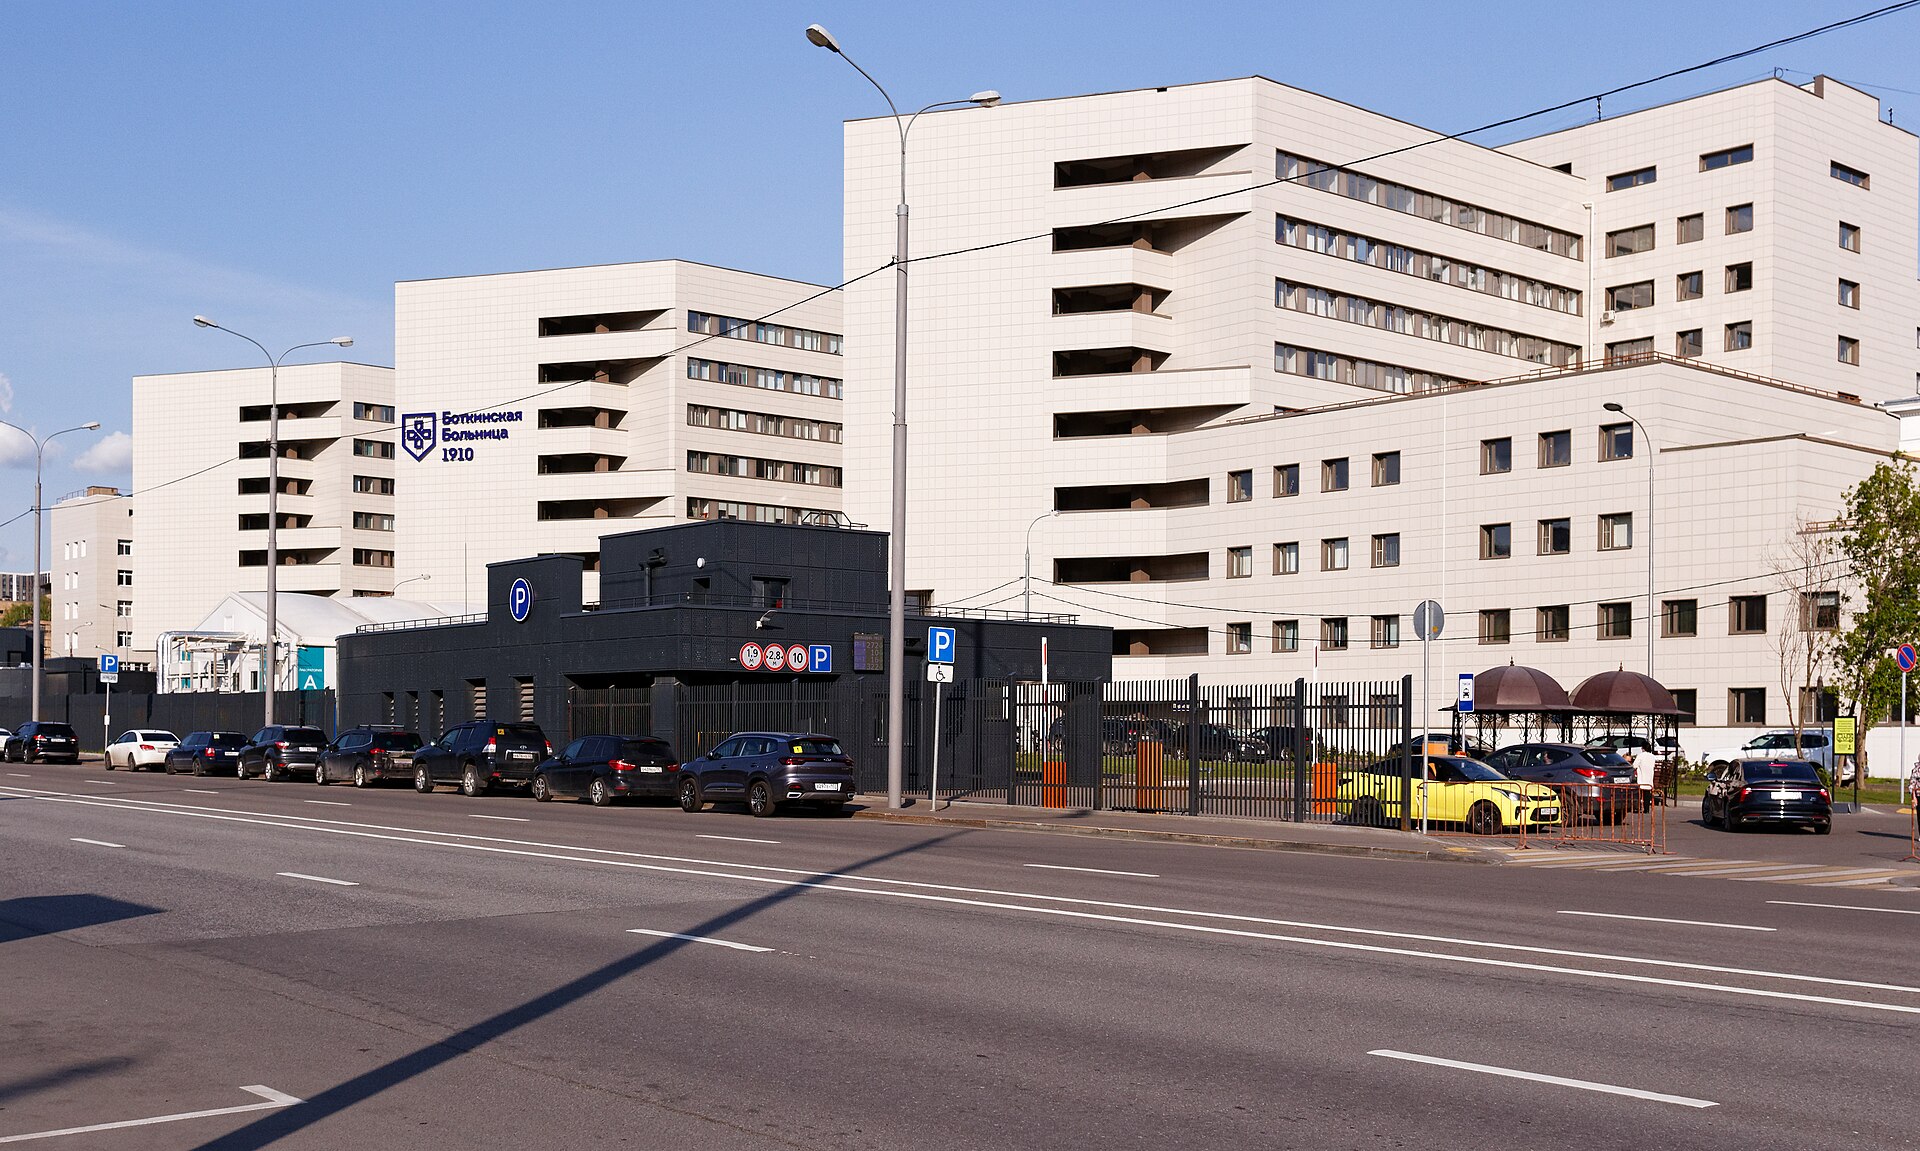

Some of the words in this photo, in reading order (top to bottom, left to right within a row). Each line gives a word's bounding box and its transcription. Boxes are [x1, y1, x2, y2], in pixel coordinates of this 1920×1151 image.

[442, 411, 523, 426] Боткинская
[442, 428, 509, 442] Больница
[442, 447, 474, 462] 1910
[516, 587, 526, 614] P
[936, 631, 951, 659] P
[105, 656, 116, 671] P
[792, 652, 804, 664] 10
[815, 648, 828, 669] P
